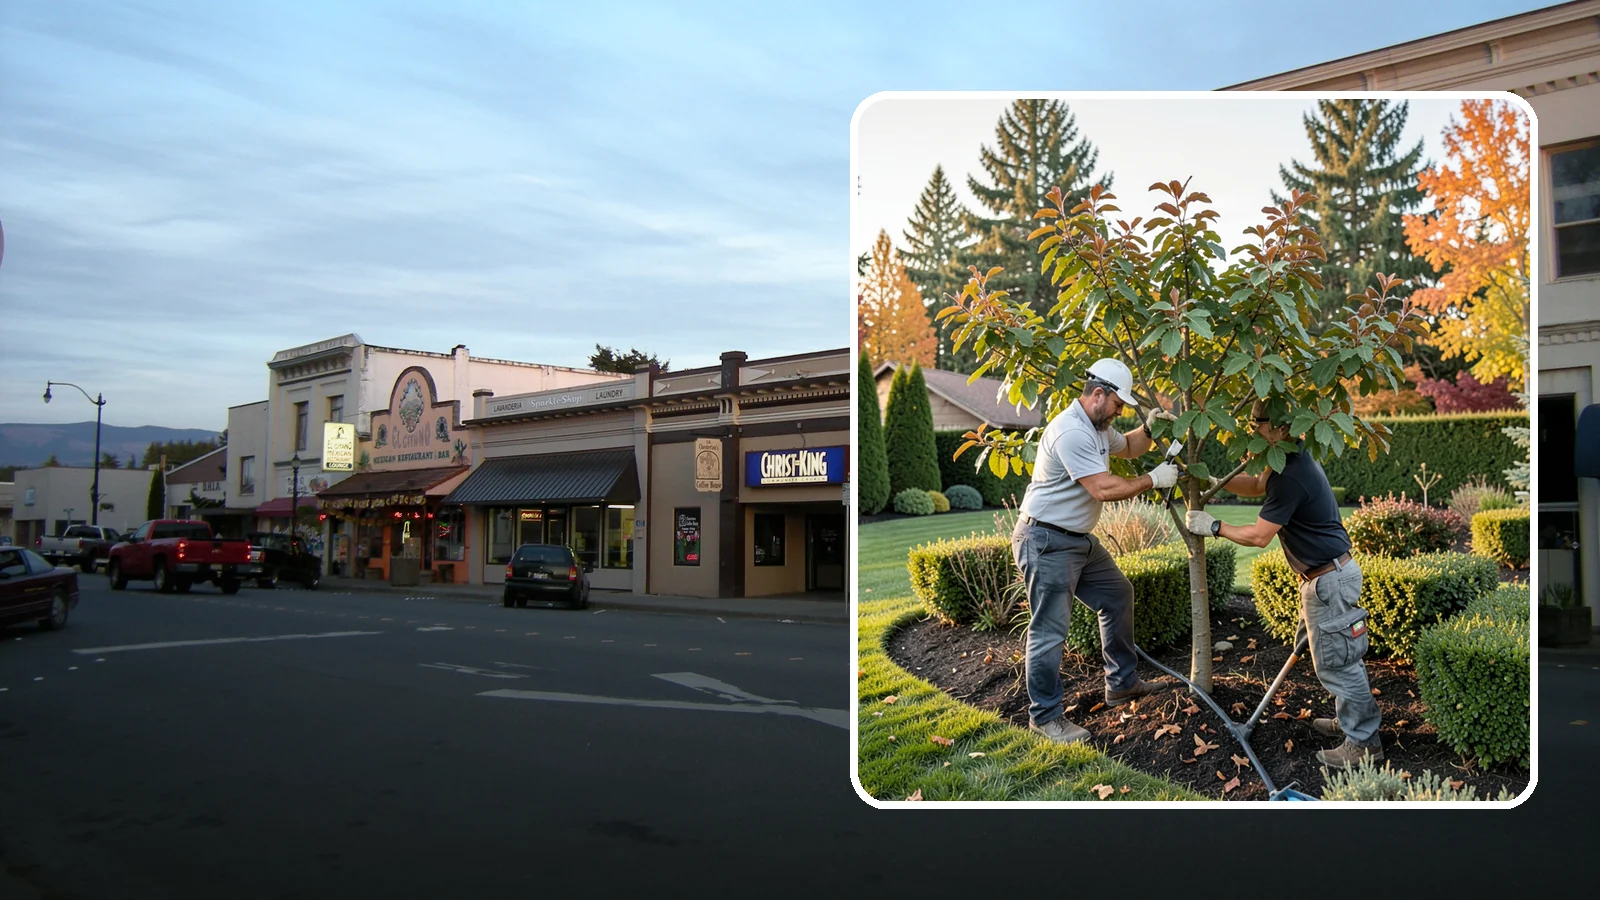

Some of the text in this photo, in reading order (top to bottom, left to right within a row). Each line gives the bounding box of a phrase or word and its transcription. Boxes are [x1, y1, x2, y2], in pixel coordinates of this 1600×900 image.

[494, 388, 624, 413] LAVANDERIA Sparkle Shop LAUNDRY
[392, 425, 401, 449] EL
[373, 450, 450, 464] MEXICAN RESTAURANT BAR
[760, 452, 797, 478] CHRIST
[799, 449, 827, 476] KING
